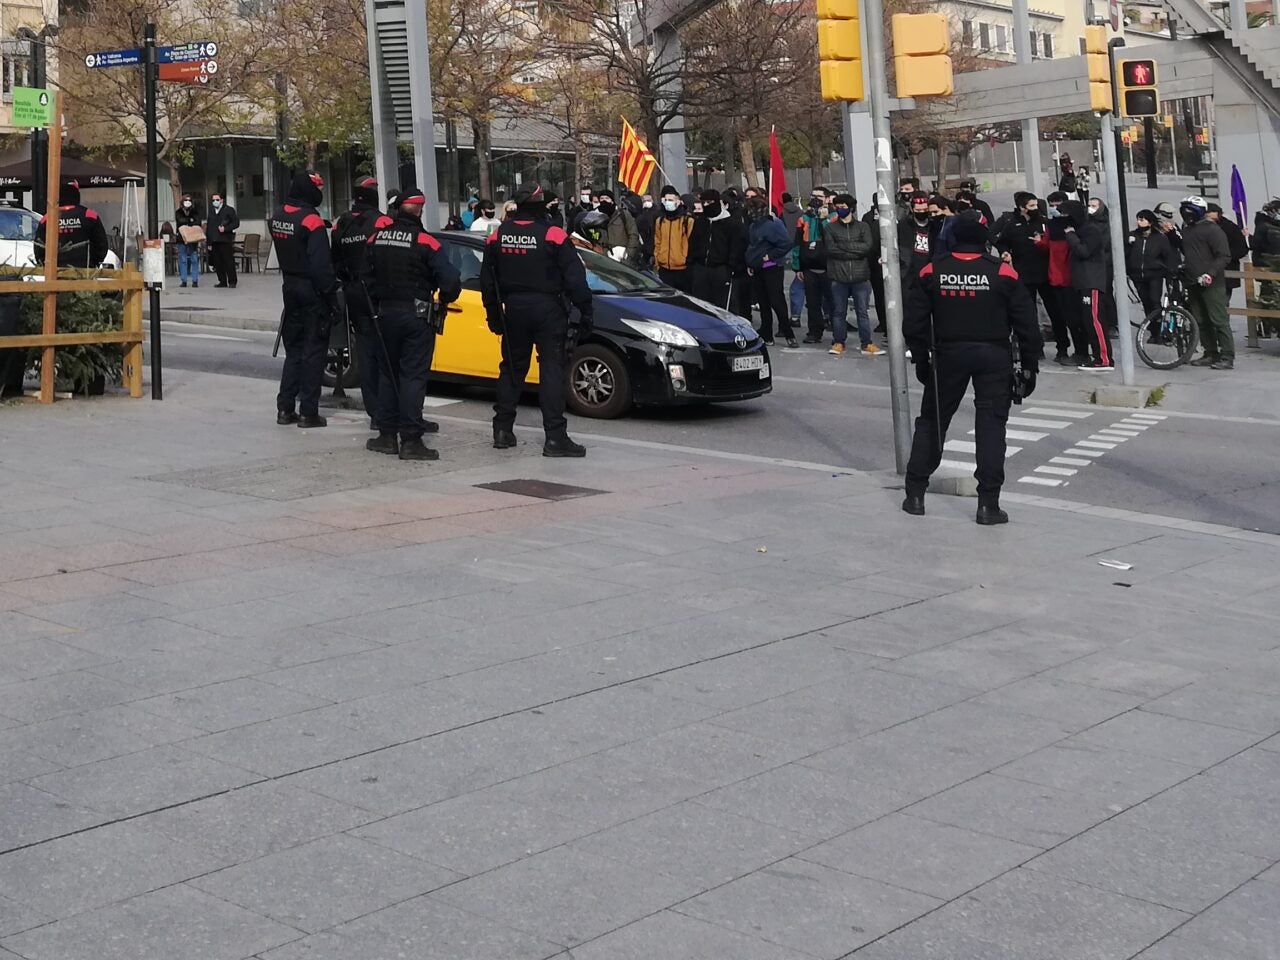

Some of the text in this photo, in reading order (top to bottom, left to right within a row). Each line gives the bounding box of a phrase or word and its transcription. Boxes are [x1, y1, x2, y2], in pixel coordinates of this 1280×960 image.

[59, 218, 81, 226] OLICIA
[272, 220, 294, 231] POLICIA
[341, 234, 367, 244] POLICIA
[376, 230, 412, 242] POLICIA
[501, 234, 537, 245] POLICIA
[940, 274, 989, 285] POLICIA
